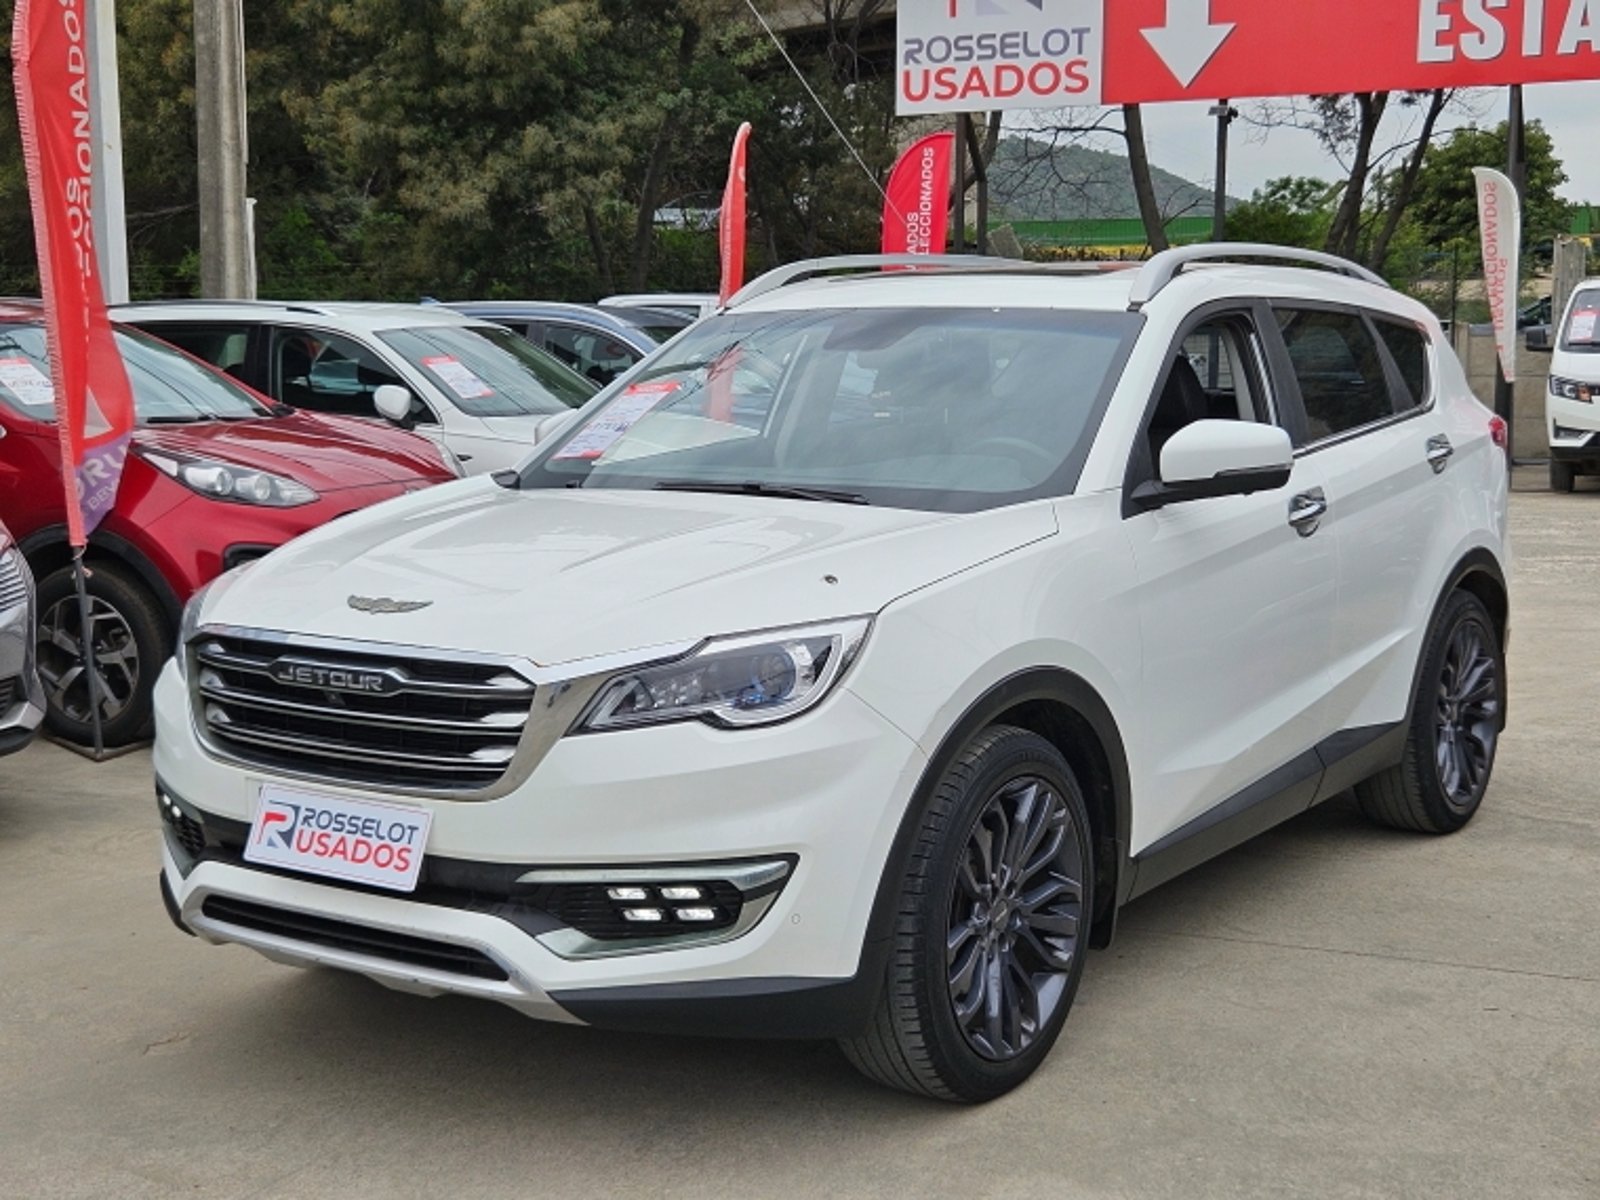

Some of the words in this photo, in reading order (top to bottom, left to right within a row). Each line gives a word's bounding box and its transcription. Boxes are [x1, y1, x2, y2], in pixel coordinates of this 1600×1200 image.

[904, 27, 1091, 65] ROSSELOT
[902, 60, 1090, 103] USADOS
[278, 665, 383, 692] JETOUR
[301, 807, 419, 845] ROSSELOT
[296, 829, 412, 872] USADOS
